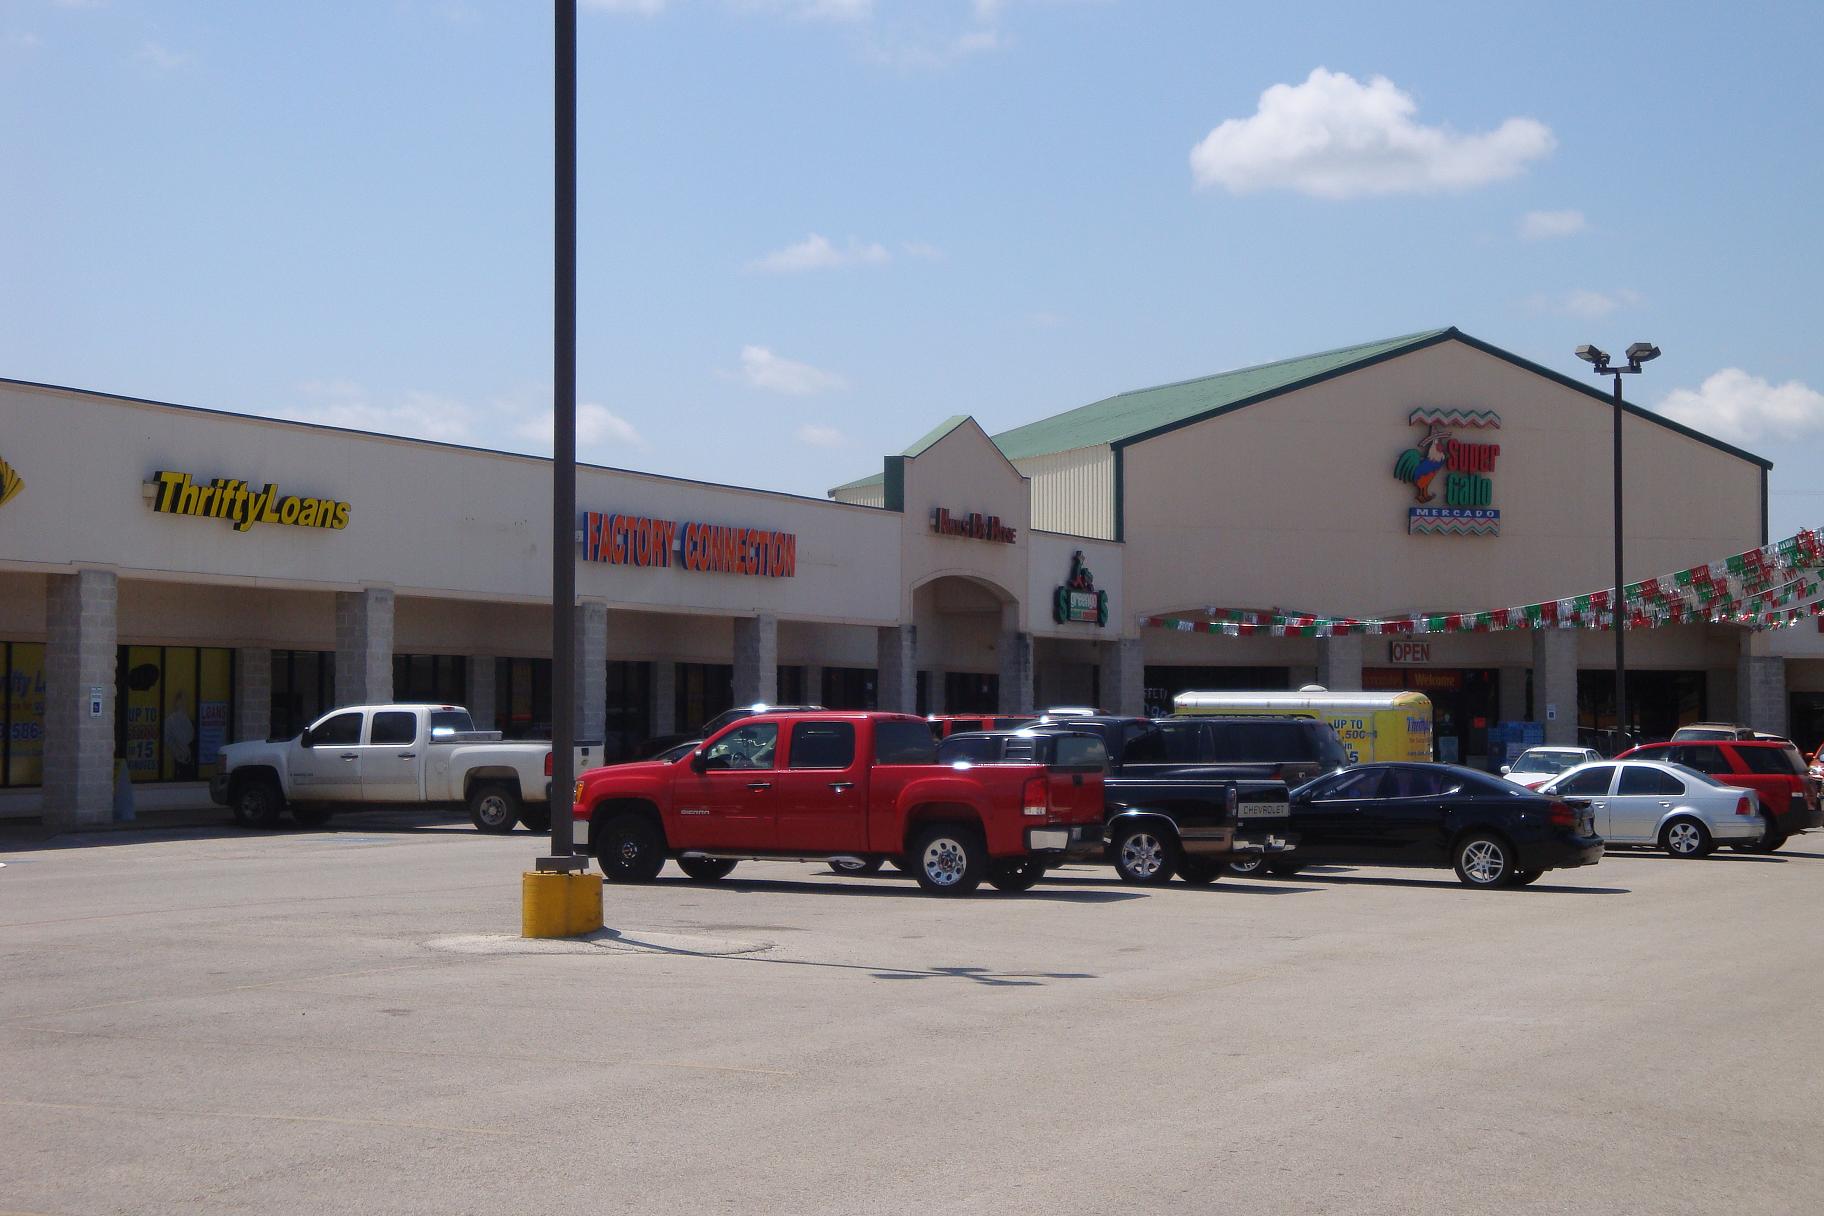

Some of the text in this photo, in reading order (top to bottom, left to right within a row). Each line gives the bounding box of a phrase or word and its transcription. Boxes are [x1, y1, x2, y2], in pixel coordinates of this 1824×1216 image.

[1446, 439, 1500, 473] Super
[1446, 473, 1493, 506] Gallo
[1415, 508, 1496, 518] MERCADO
[583, 511, 797, 577] FACTORY CONNECTION
[1393, 643, 1430, 661] OPEN
[1414, 672, 1456, 687] Welcome
[128, 707, 157, 721] UP TO
[1333, 719, 1363, 729] UP TO
[1243, 805, 1285, 815] CHEVROLET
